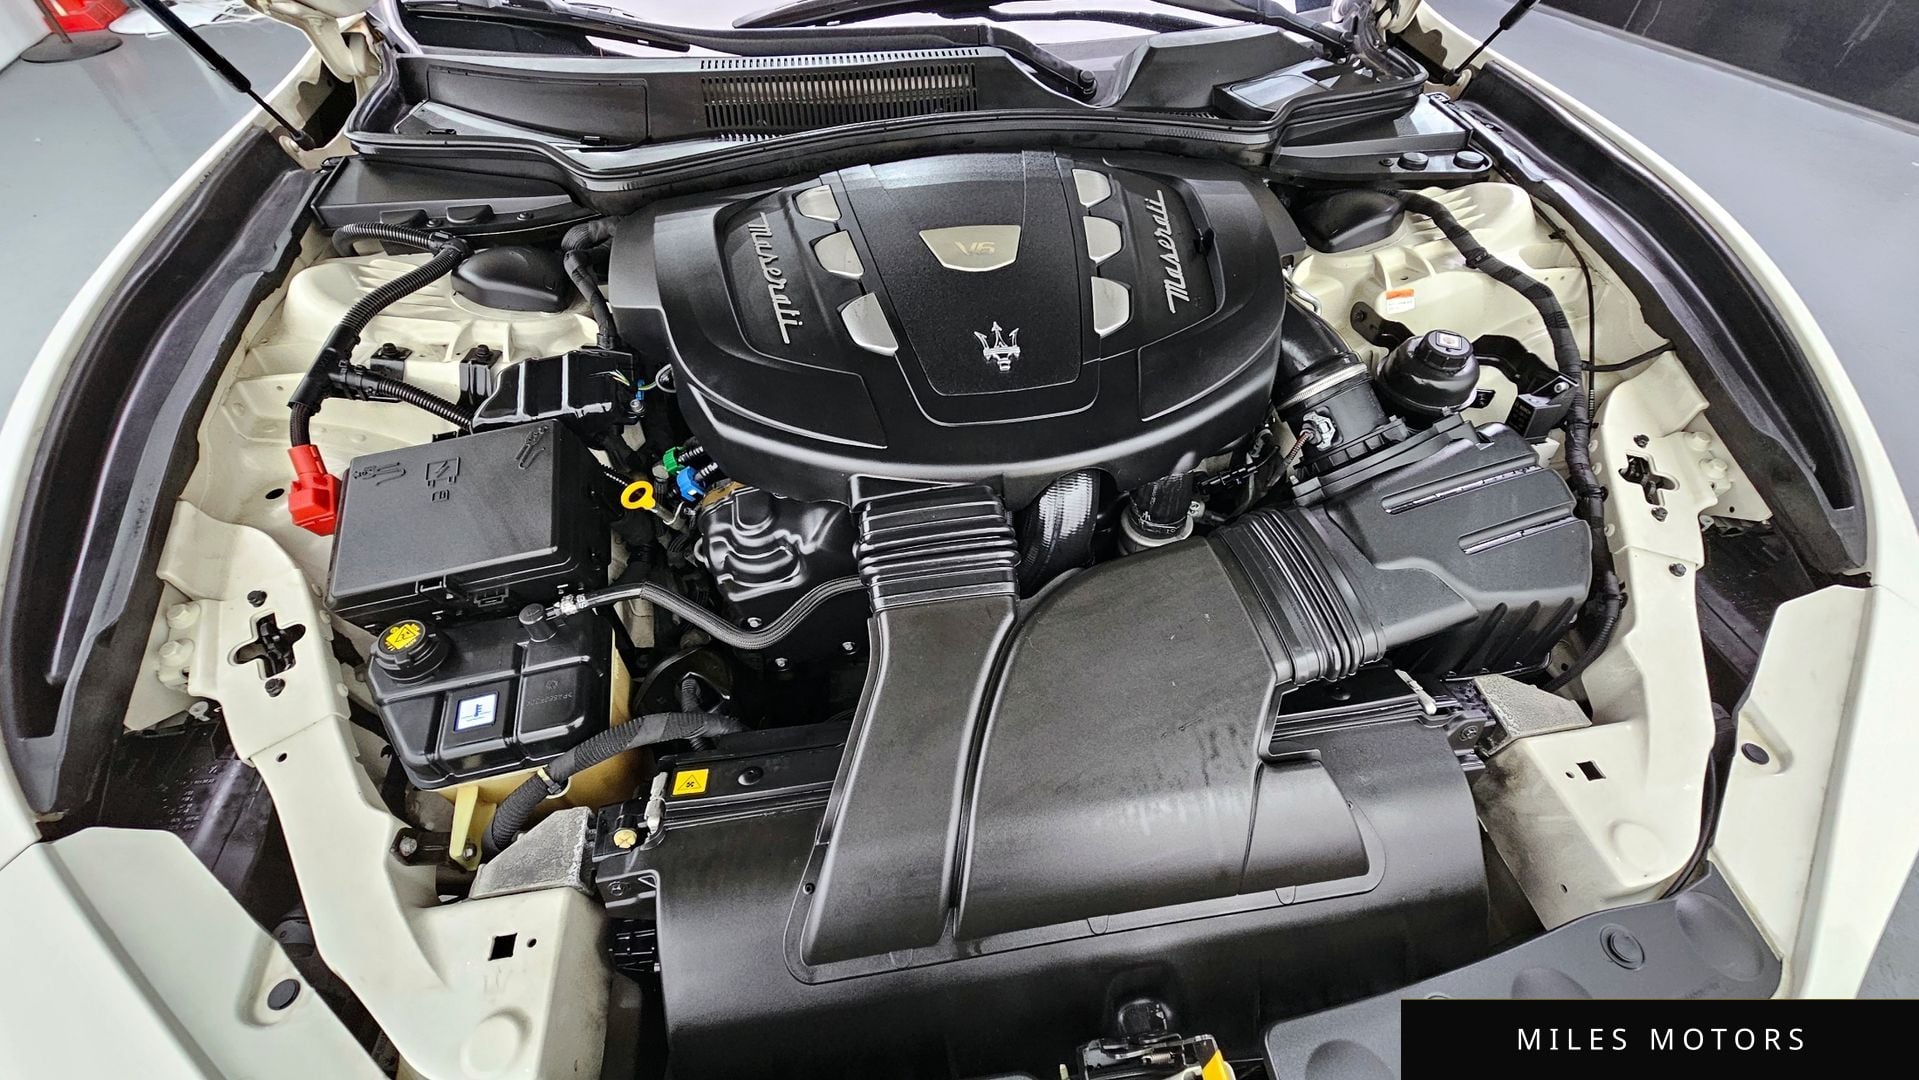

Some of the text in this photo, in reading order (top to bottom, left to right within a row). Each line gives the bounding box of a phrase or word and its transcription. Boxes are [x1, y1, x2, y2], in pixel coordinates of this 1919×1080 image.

[747, 211, 804, 345] Maserati
[954, 240, 996, 256] V6
[1144, 189, 1190, 314] Maserati
